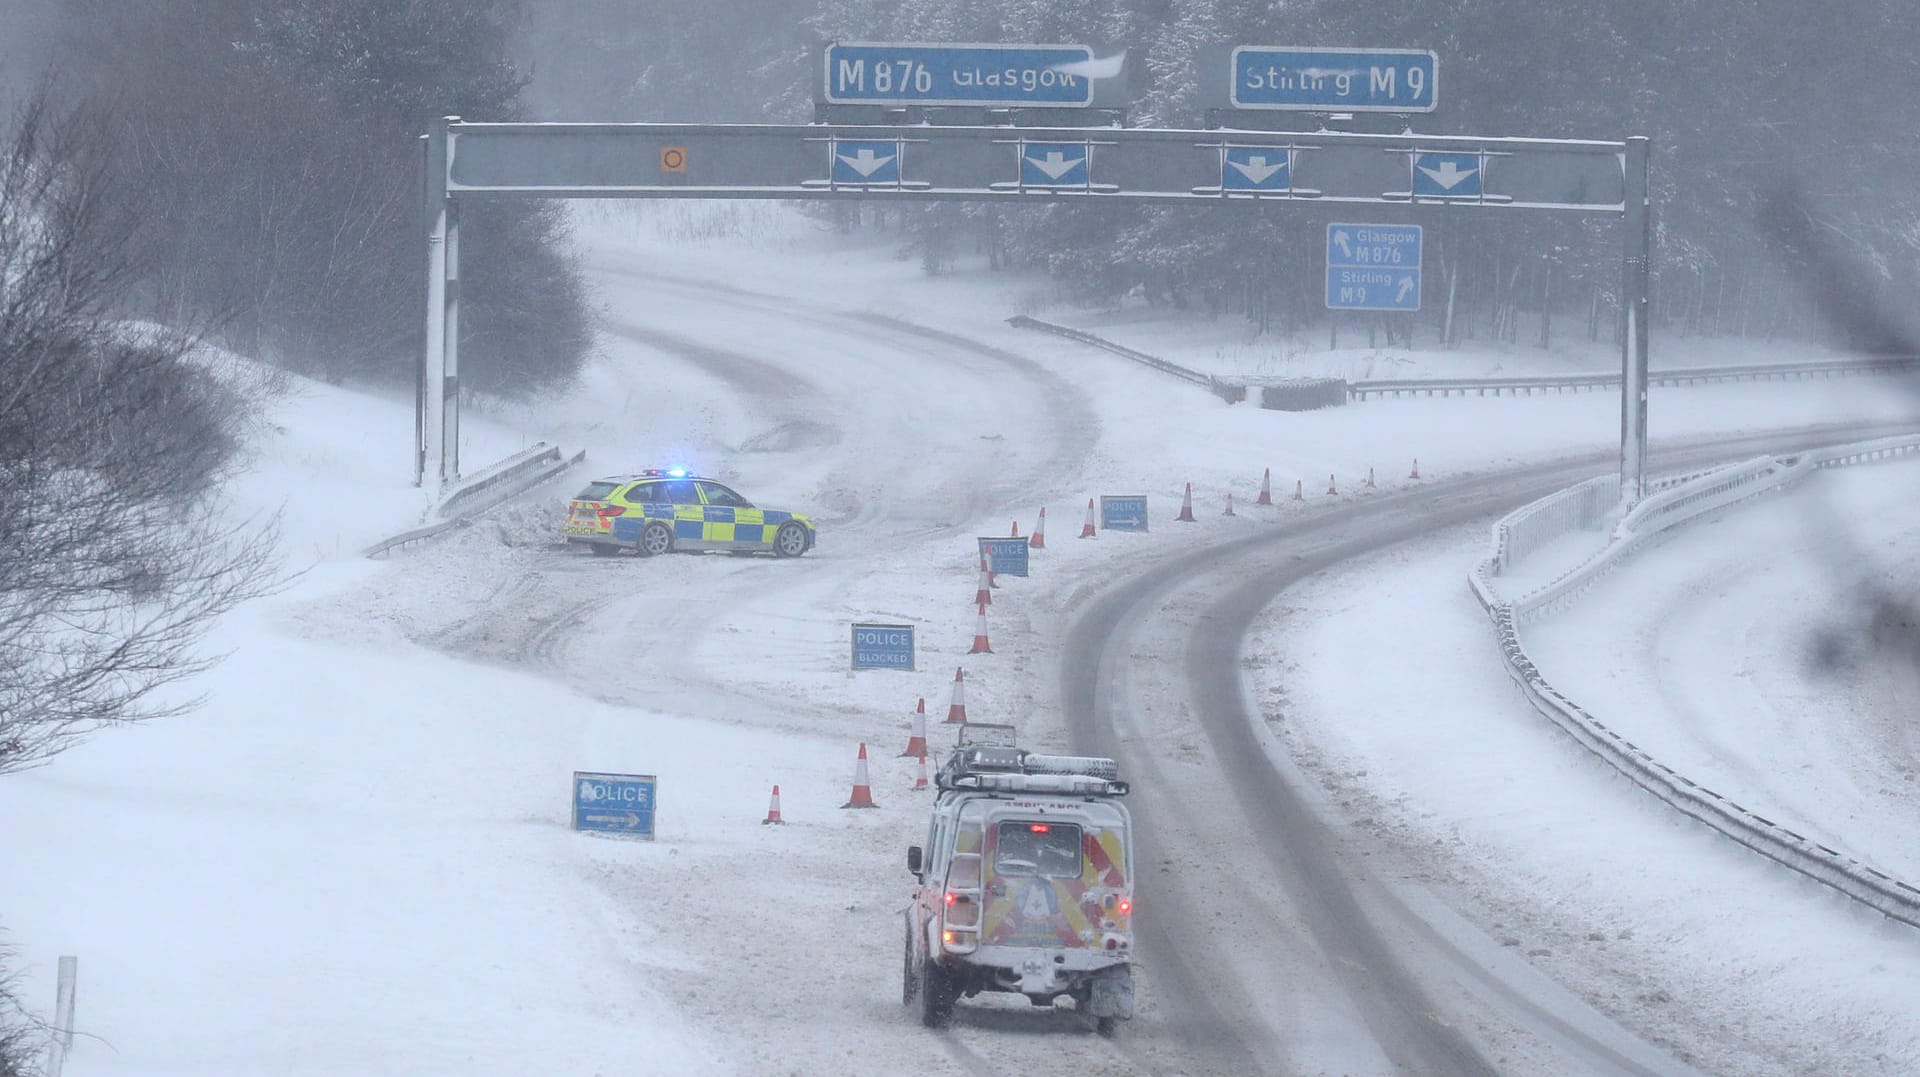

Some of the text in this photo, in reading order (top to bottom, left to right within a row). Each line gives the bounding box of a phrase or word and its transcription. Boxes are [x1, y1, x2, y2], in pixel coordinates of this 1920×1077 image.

[839, 59, 932, 93] M 876
[953, 67, 1077, 92] Glasgow
[1369, 66, 1425, 100] M 9
[1357, 230, 1416, 244] Glasgow
[1356, 246, 1401, 263] M 876
[1342, 271, 1392, 286] Stirling
[1341, 287, 1366, 304] M 9
[1103, 502, 1143, 511] POLICE
[985, 543, 1024, 553] OLICE
[857, 632, 909, 646] POLICE
[859, 653, 908, 663] BLOCKED
[581, 784, 648, 802] OLICE
[1005, 801, 1081, 810] AMBUANCE
